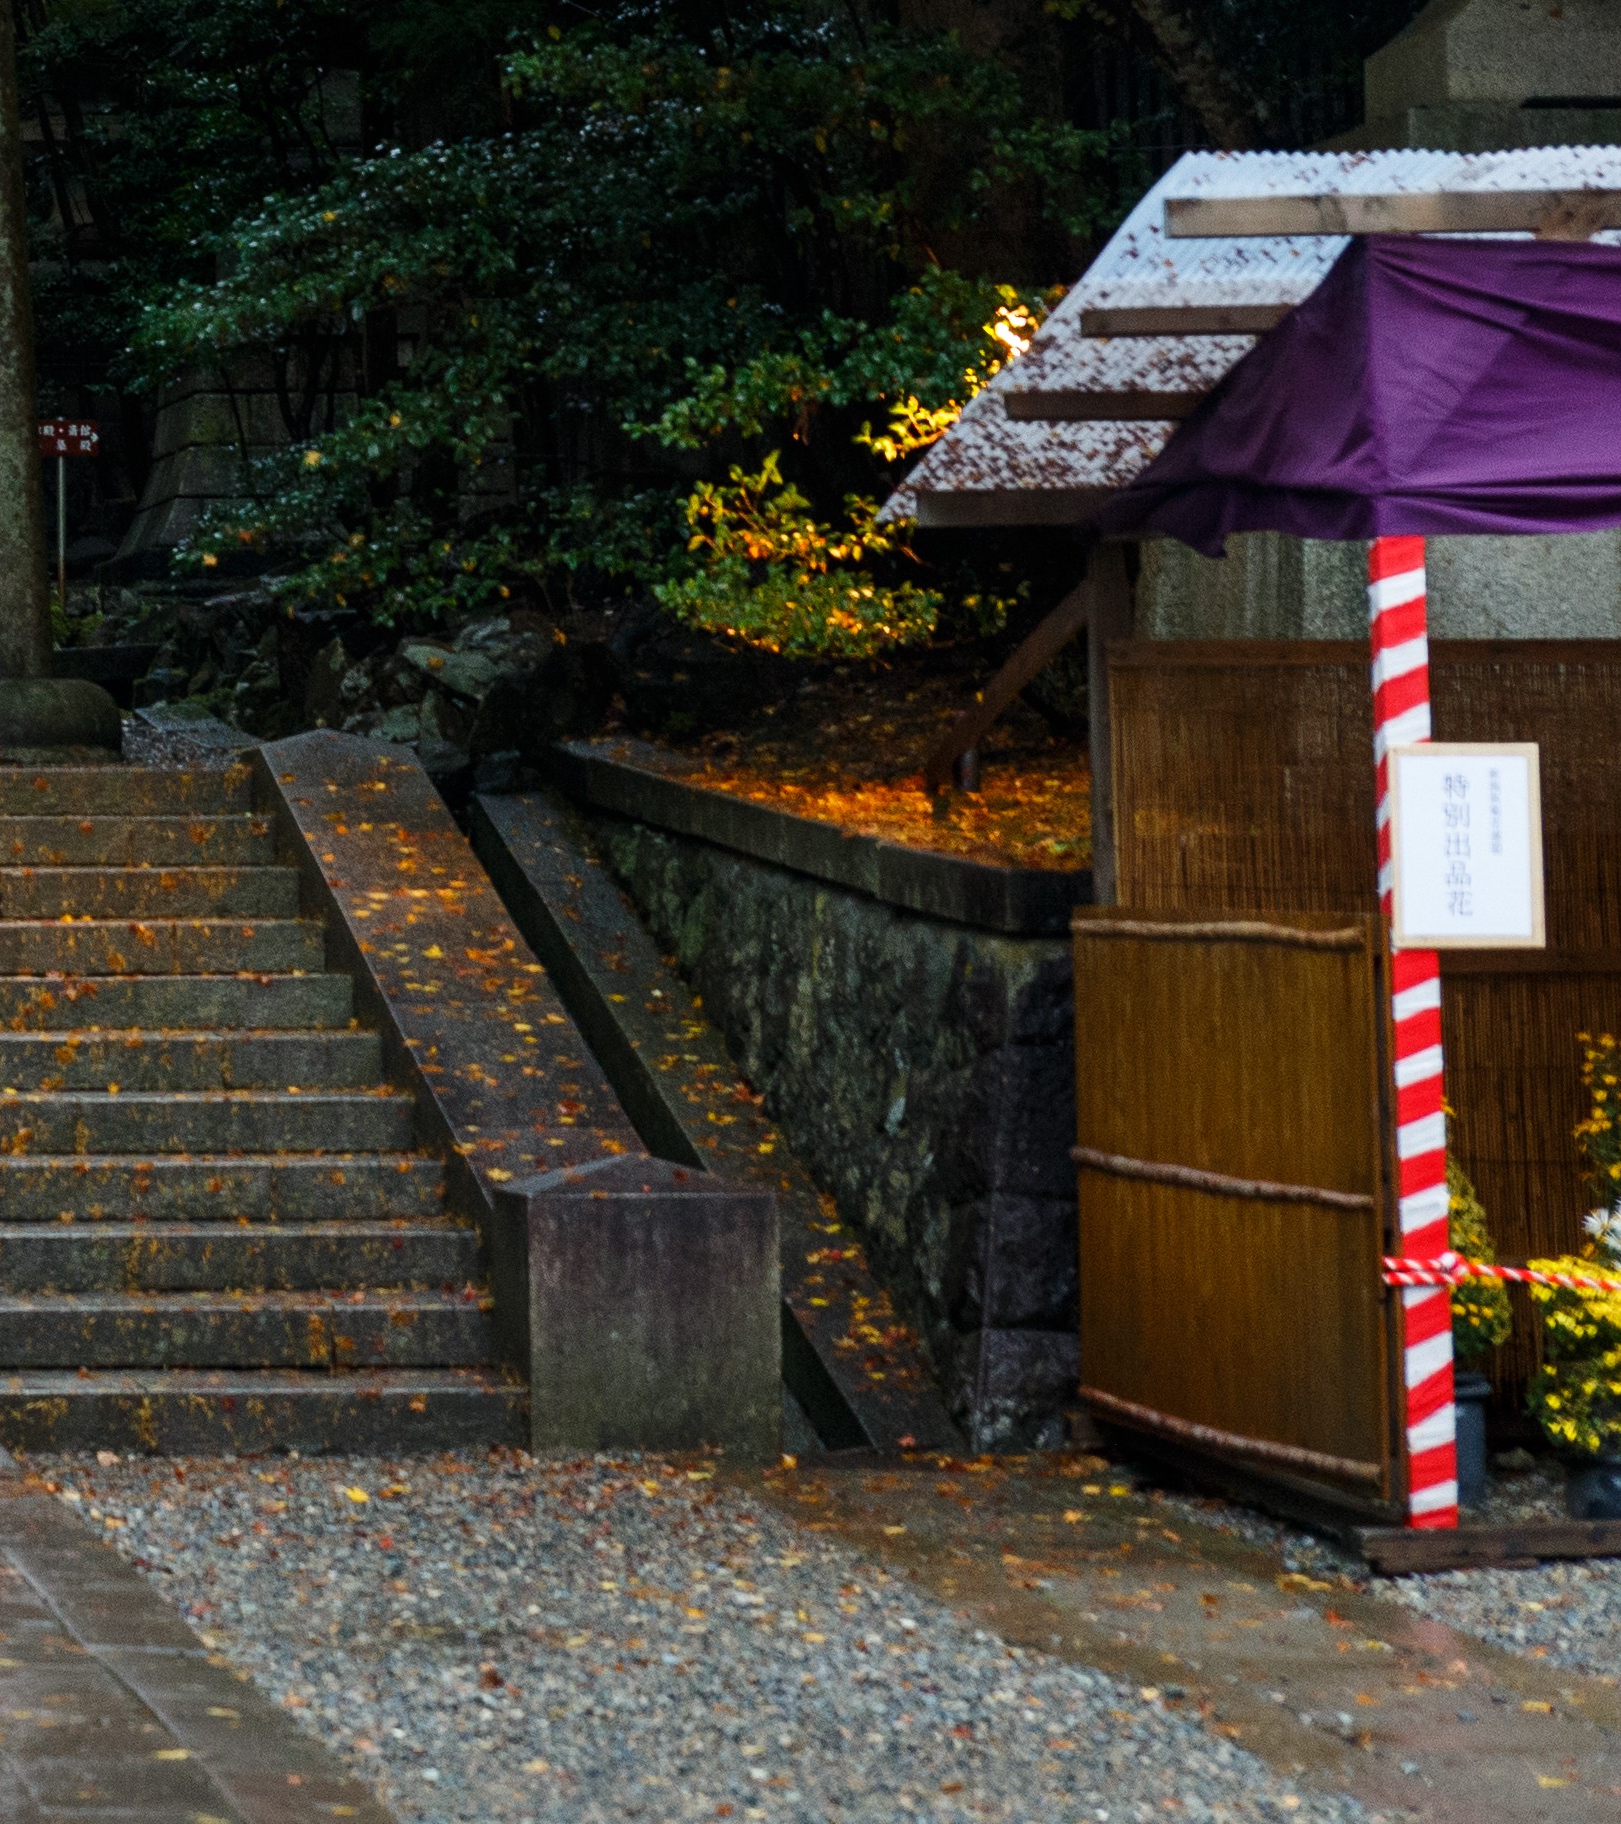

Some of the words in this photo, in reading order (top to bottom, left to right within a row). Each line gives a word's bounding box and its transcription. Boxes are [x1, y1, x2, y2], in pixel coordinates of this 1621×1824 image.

[1442, 773, 1474, 917] 特別出品花
